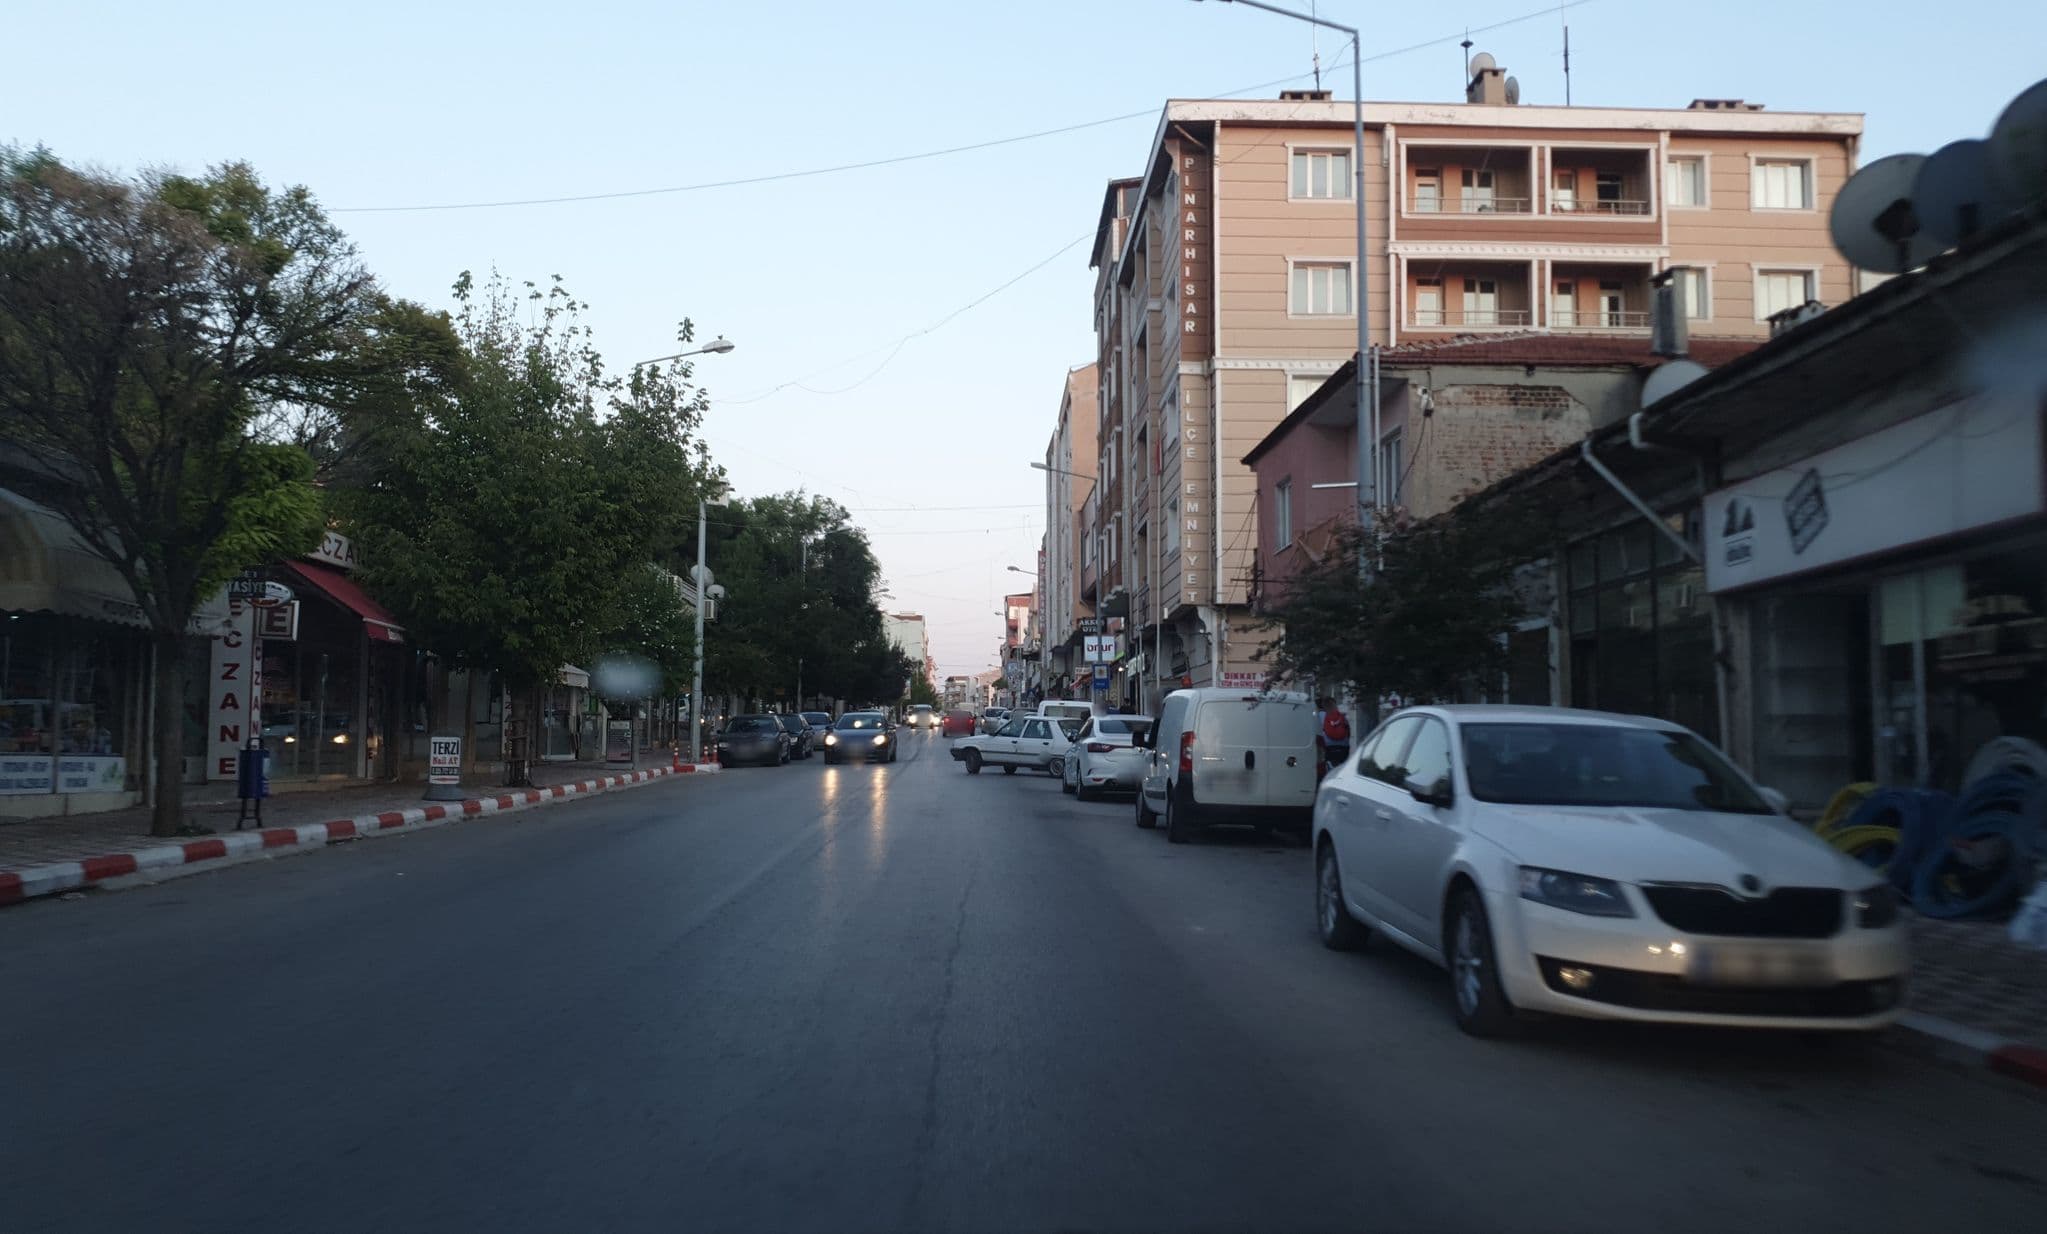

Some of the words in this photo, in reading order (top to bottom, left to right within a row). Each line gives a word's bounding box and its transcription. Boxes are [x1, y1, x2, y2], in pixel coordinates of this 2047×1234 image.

[1184, 157, 1198, 333] PINARHISAR
[1185, 389, 1198, 459] İLÇE
[1186, 484, 1200, 602] EMNİYET
